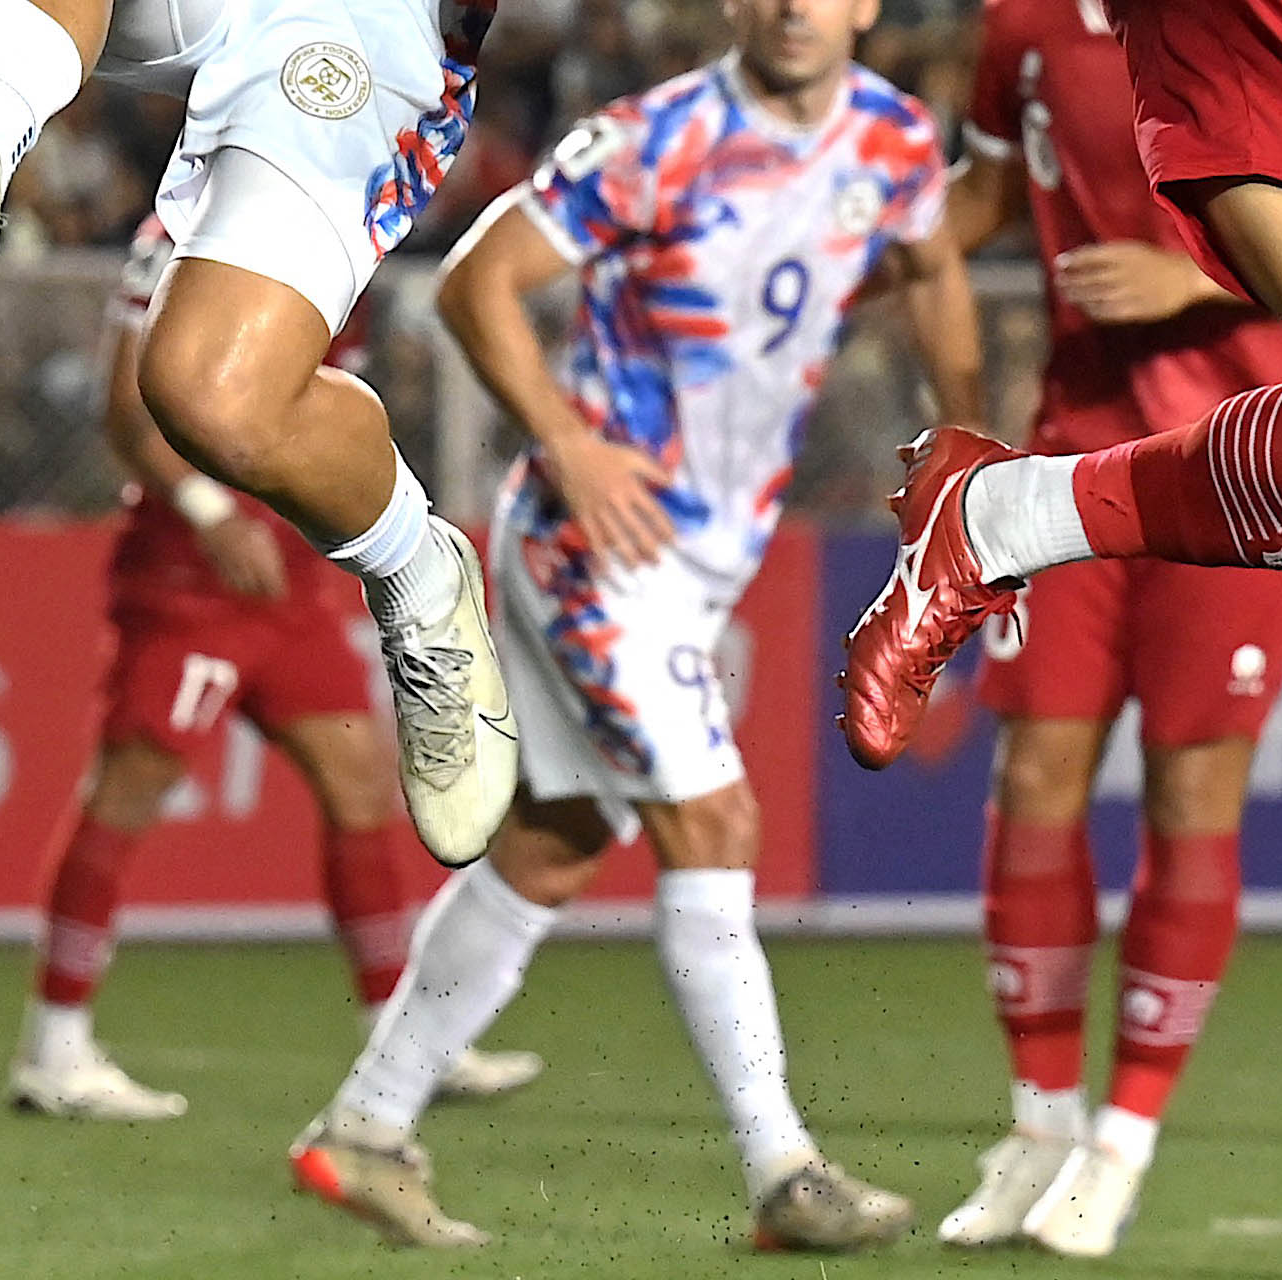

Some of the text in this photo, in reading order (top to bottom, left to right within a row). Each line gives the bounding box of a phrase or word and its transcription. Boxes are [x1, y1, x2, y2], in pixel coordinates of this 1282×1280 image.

[761, 258, 811, 356] 9
[169, 652, 239, 733] 17
[667, 643, 715, 718] 9
